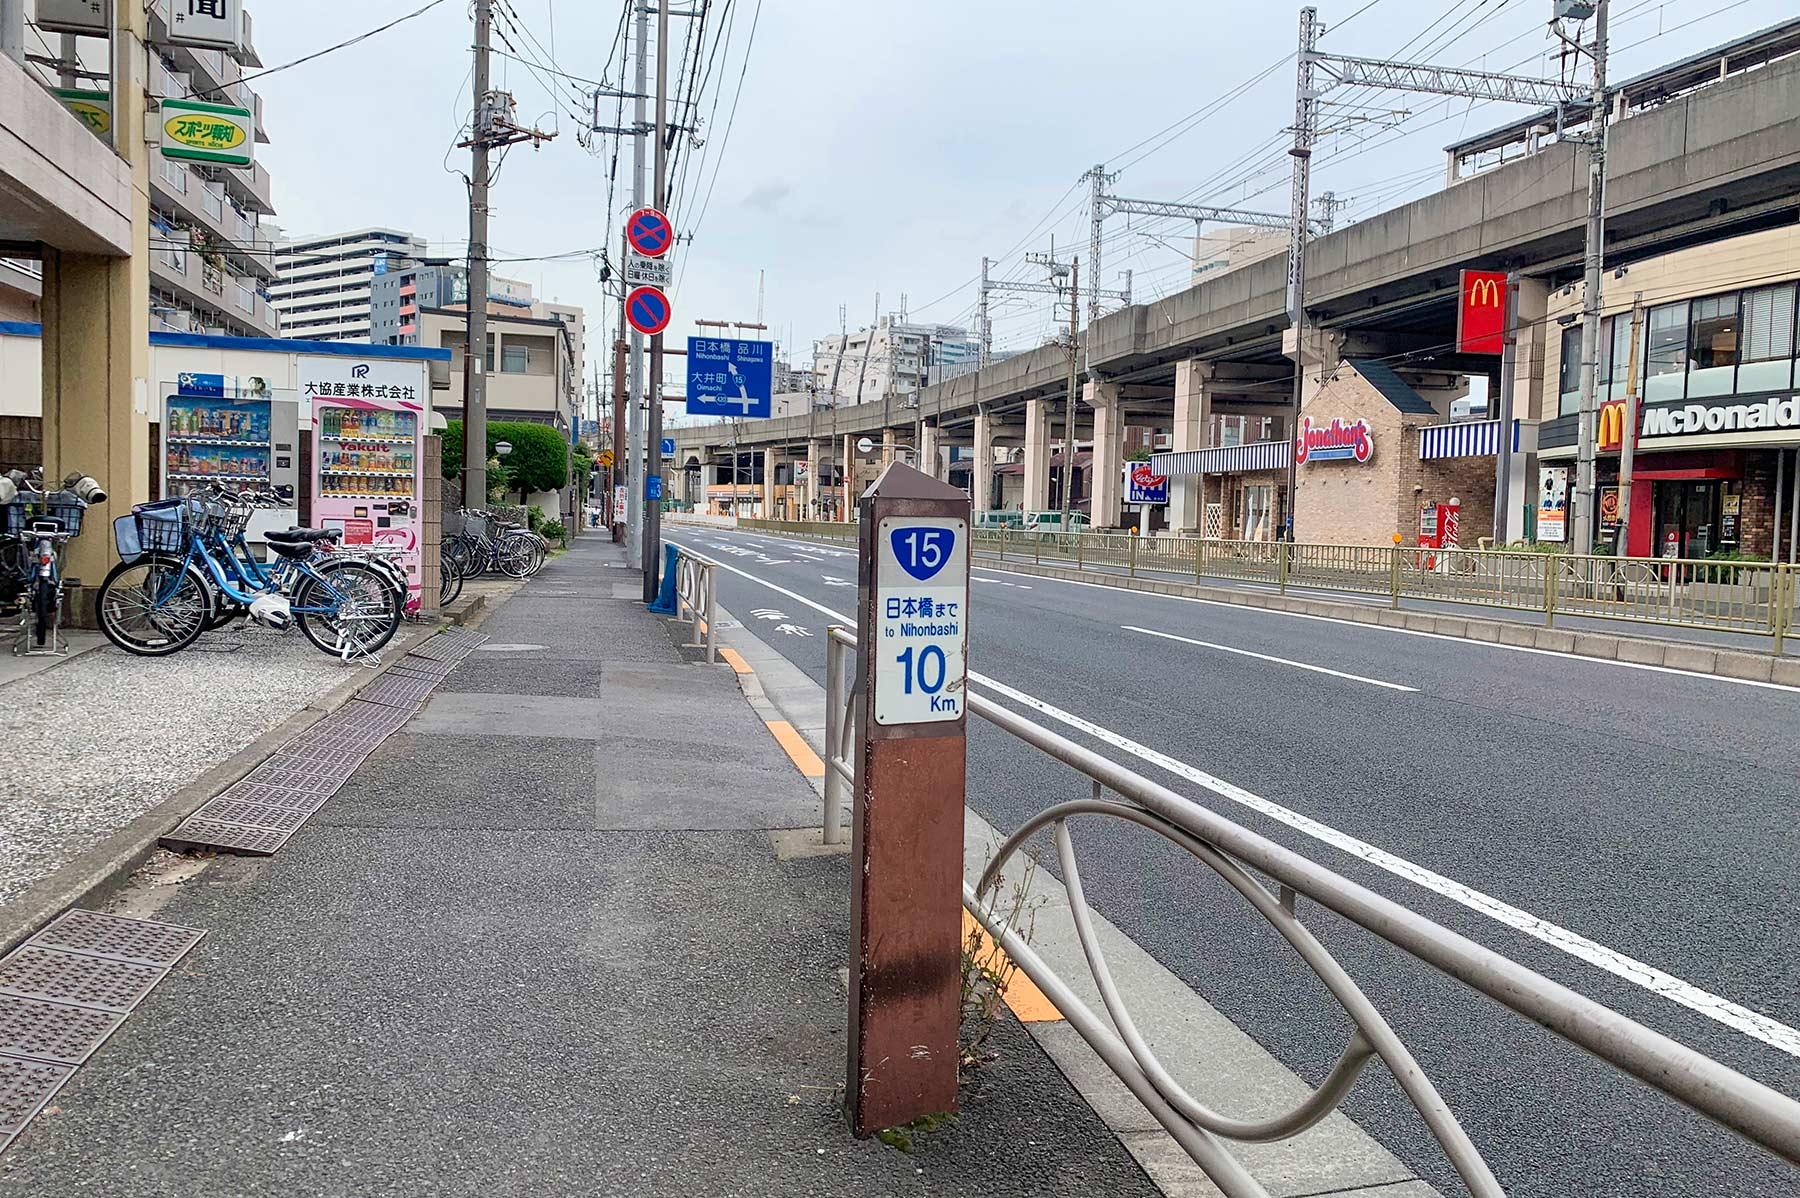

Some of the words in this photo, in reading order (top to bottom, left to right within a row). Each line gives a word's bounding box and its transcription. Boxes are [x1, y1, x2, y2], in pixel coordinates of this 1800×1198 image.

[174, 120, 235, 143] スポーツ報知
[695, 340, 731, 354] 日本橋
[695, 352, 730, 361] Nihonbashi
[691, 372, 727, 385] 大井町
[734, 376, 743, 384] 15
[304, 381, 416, 400] 大協産業株式会社
[696, 383, 723, 392] Oimachi
[339, 442, 391, 453] Yakult
[1296, 417, 1369, 464] Jonathan's
[904, 532, 942, 568] 15
[886, 597, 958, 619] 日本橋まで
[885, 627, 895, 638] to
[900, 622, 959, 637] Nihonbashi
[896, 645, 946, 695] 10
[930, 695, 956, 712] Km
